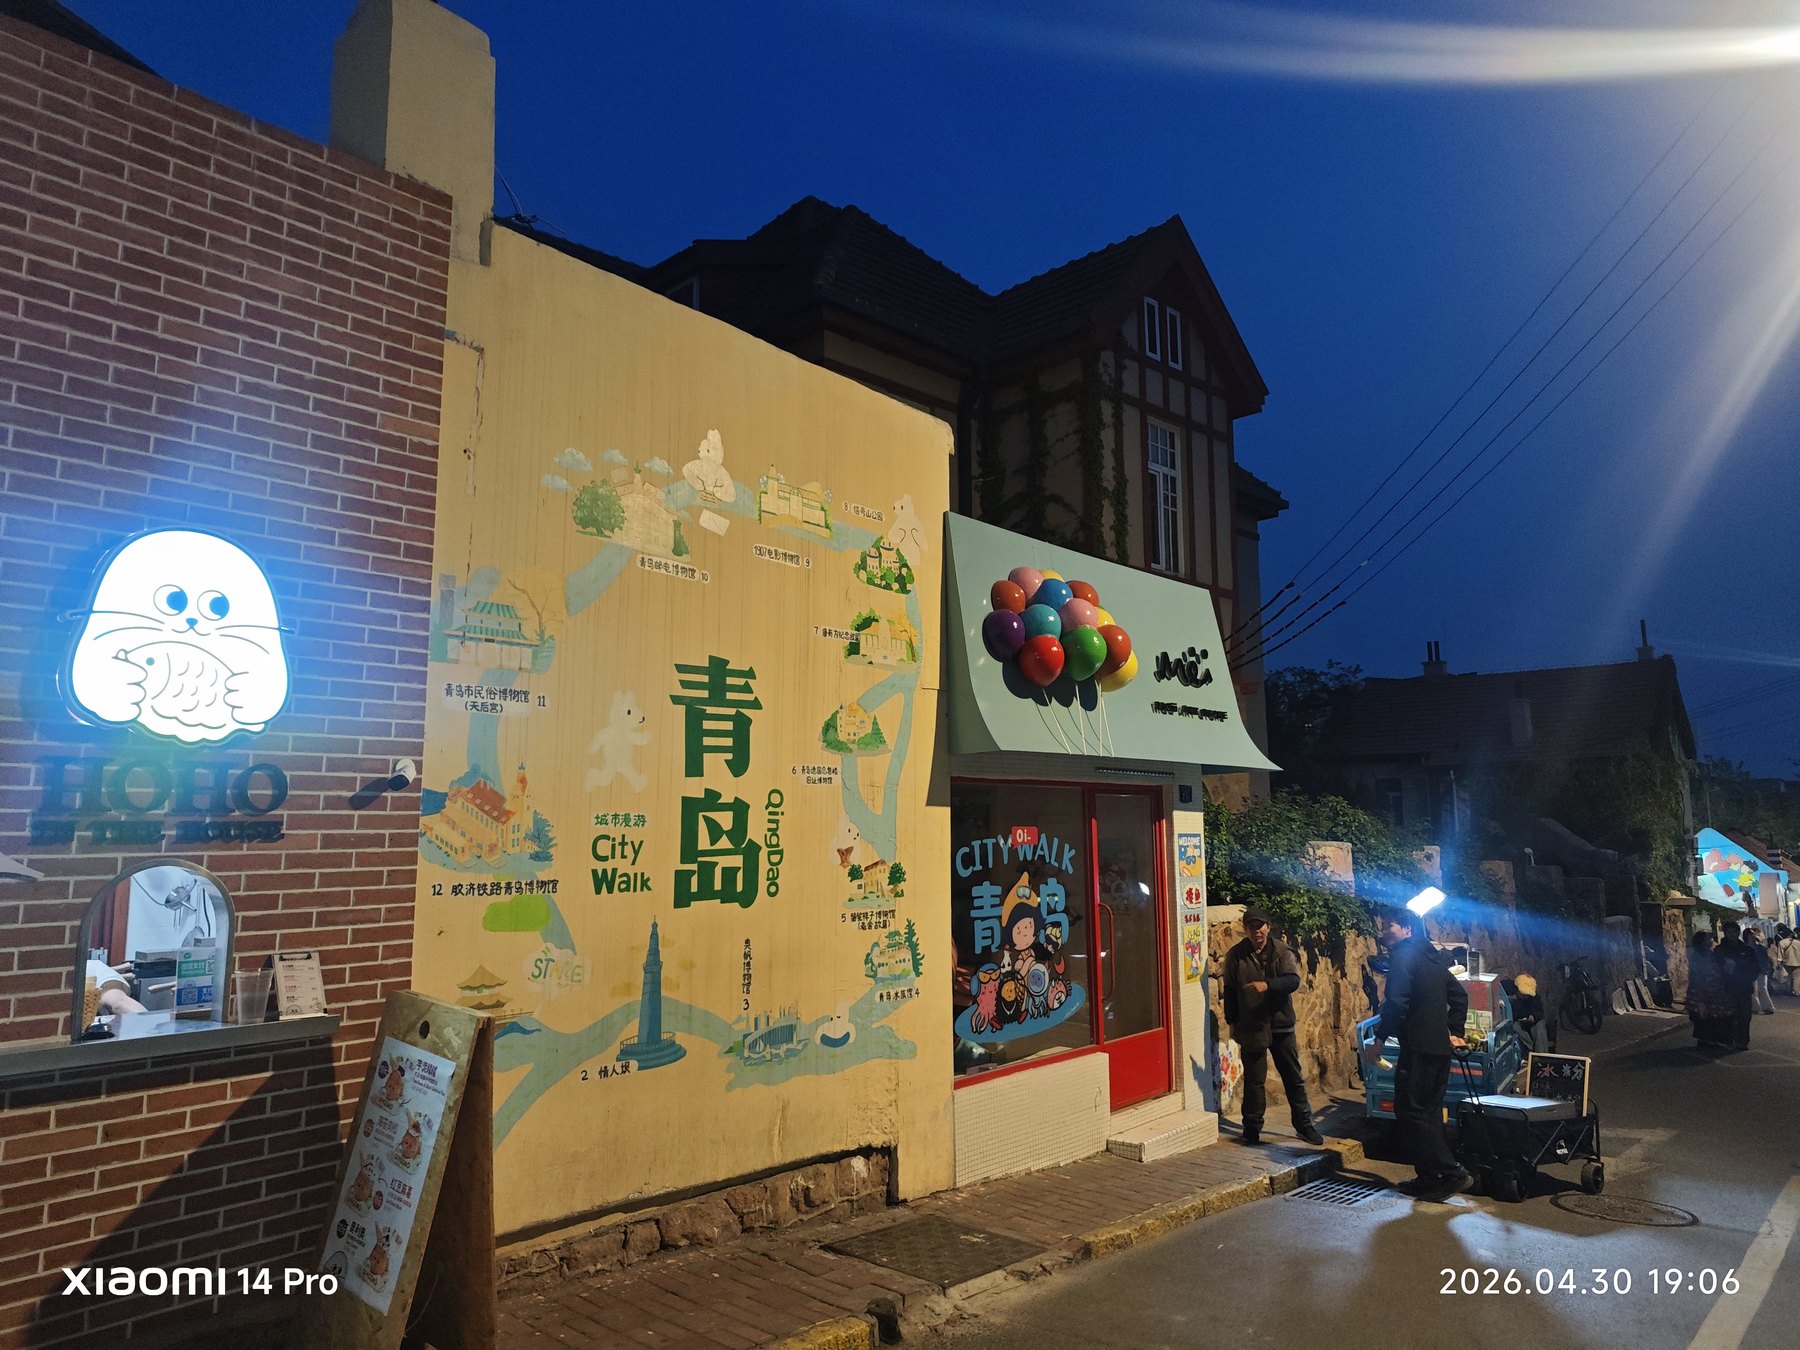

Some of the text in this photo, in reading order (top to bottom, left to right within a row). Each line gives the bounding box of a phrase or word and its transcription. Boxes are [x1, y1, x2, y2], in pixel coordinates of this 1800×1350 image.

[805, 558, 811, 568] 9
[701, 572, 709, 582] 10
[813, 626, 819, 636] 7
[444, 682, 547, 708] 青岛市民俗博物馆 11
[464, 700, 504, 714] (天后宫)
[791, 765, 797, 775] 6
[38, 757, 289, 817] HOHO
[669, 654, 764, 909] 青岛
[594, 812, 648, 828] 城市漫游
[591, 833, 644, 866] City
[764, 788, 785, 898] QingDao
[955, 832, 1076, 878] CITY WALK
[431, 879, 559, 897] 12 胶济铁路青岛博物馆
[591, 867, 652, 895] Walk
[840, 913, 847, 924] 5
[914, 987, 921, 999] 4
[742, 998, 751, 1011] 3
[580, 1061, 631, 1081] 2 情人坝
